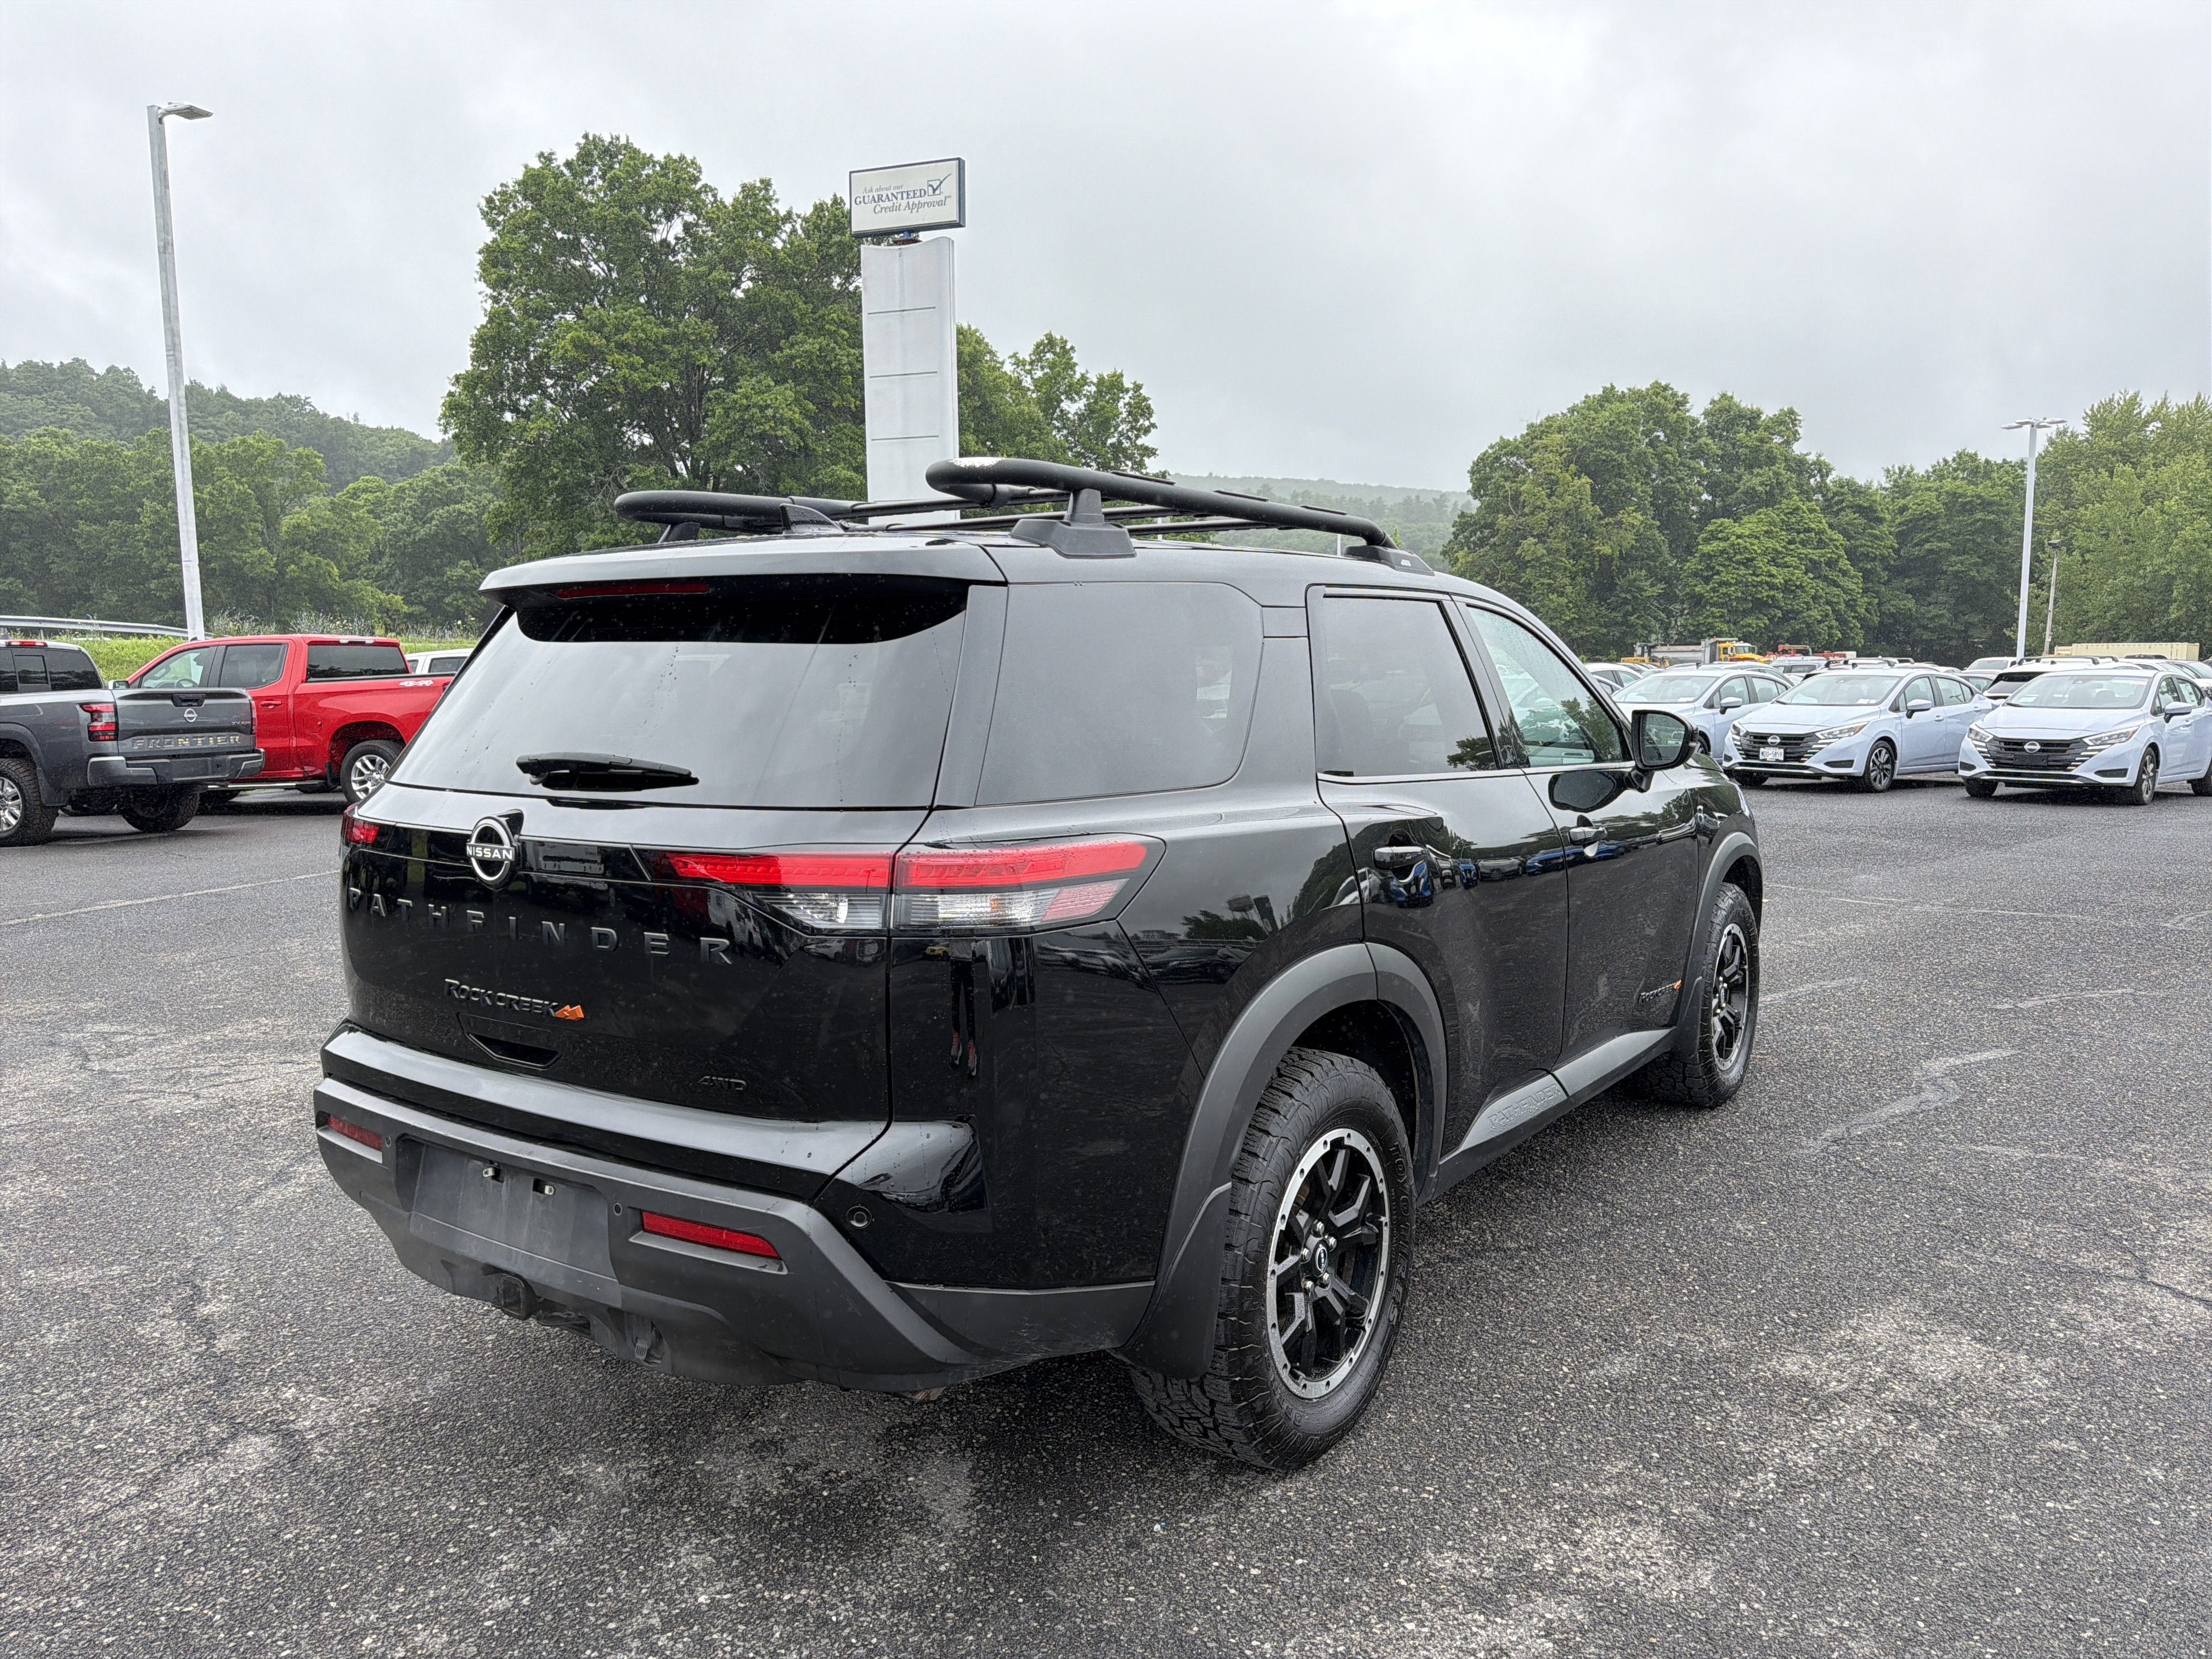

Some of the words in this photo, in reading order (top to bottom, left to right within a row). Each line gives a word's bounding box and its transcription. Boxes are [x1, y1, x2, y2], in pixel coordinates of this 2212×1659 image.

[854, 188, 927, 206] GUARANTEED
[873, 201, 902, 214] Credit
[904, 196, 948, 213] Approval
[132, 736, 241, 749] FRONTIER
[466, 845, 512, 860] NISSAN
[348, 887, 732, 965] PATHFINDER
[444, 979, 493, 1005] ROCK
[495, 992, 558, 1017] CREEK
[698, 1075, 747, 1091] 4WD
[1487, 1083, 1562, 1128] PATHFINDER
